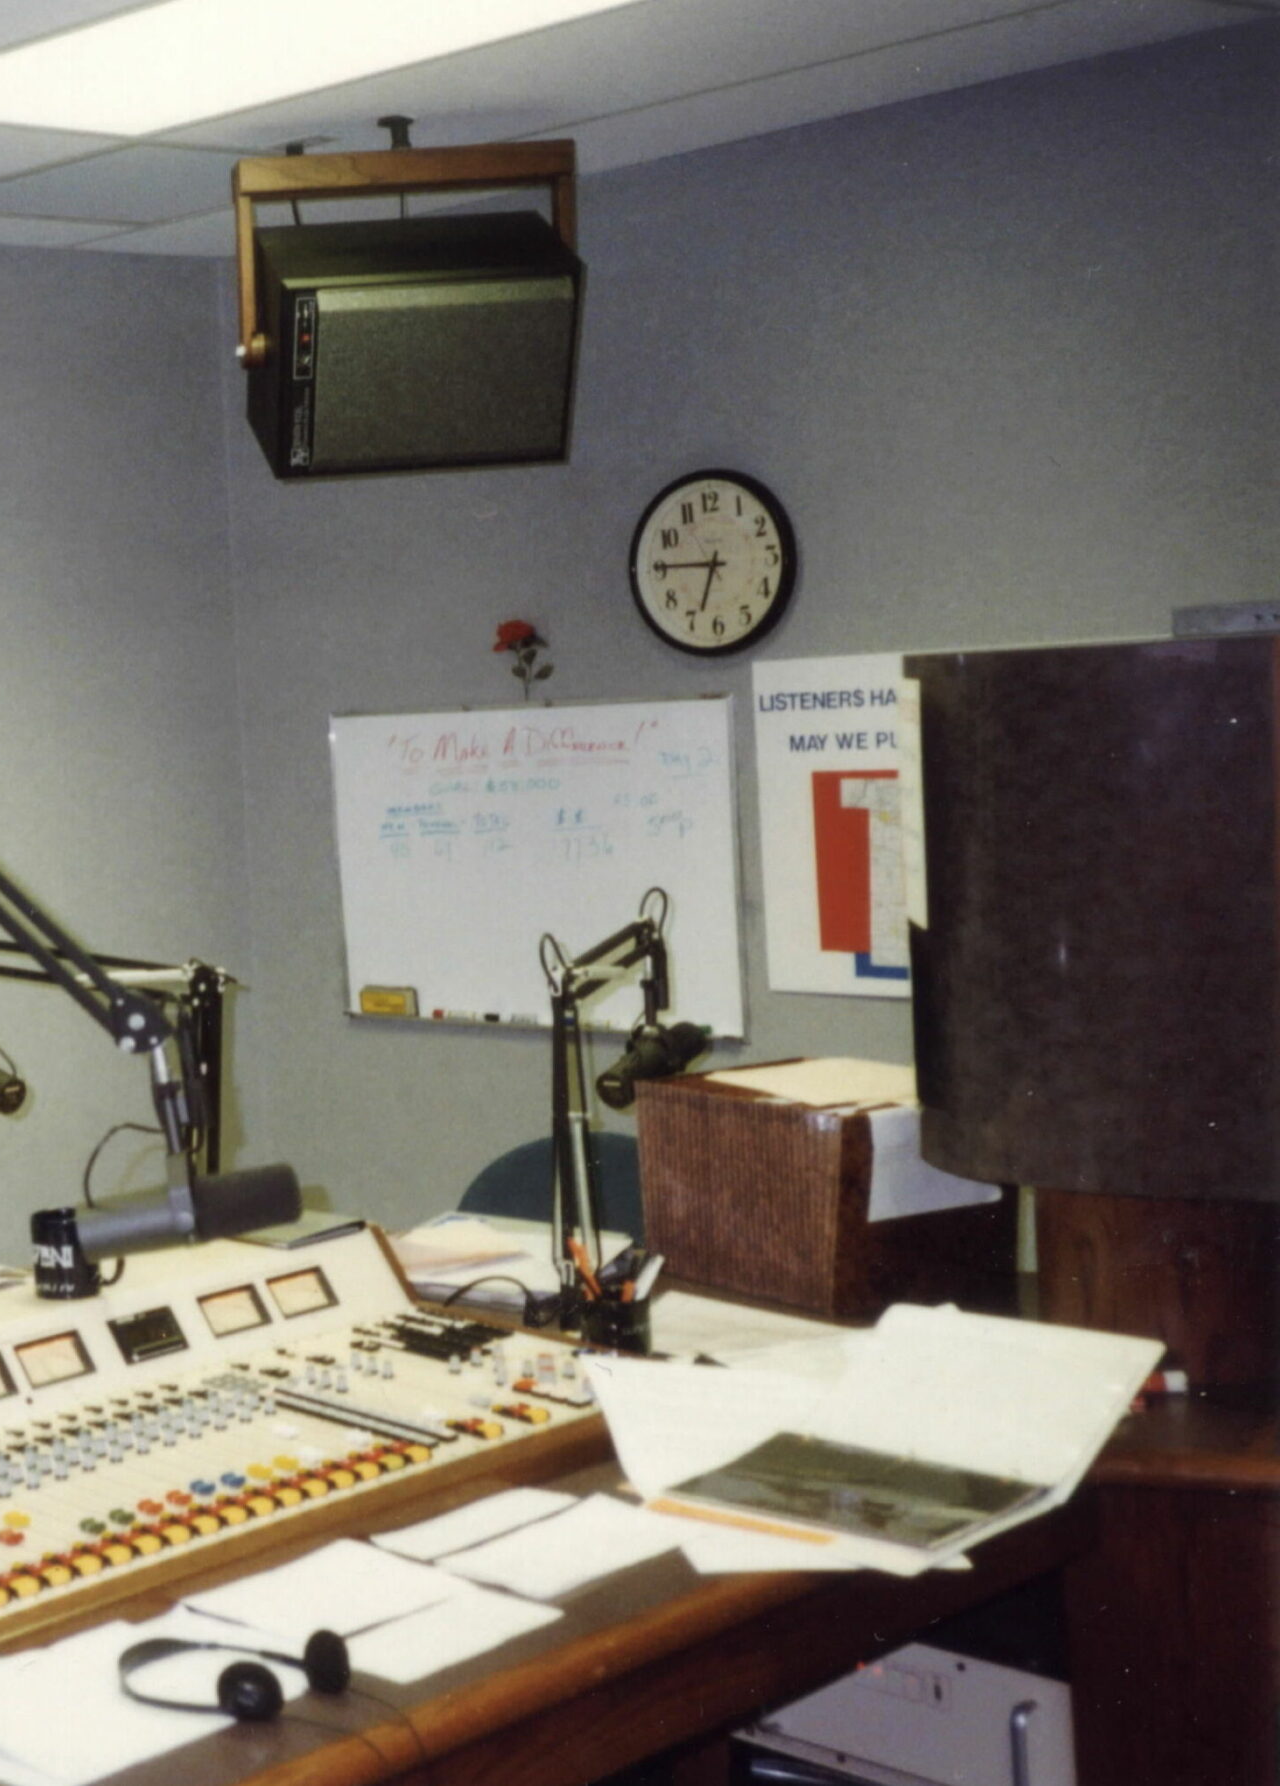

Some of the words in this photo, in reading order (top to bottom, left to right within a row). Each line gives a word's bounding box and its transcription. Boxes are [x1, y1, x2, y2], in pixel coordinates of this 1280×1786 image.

[701, 491, 720, 513] 12
[736, 495, 742, 516] 1
[680, 503, 694, 525] 11
[754, 517, 767, 537] 2
[661, 528, 679, 549] 10
[764, 545, 780, 566] 3
[757, 577, 772, 599] 4
[665, 589, 678, 609] 8
[685, 611, 698, 632] 7
[712, 615, 726, 636] 6
[738, 605, 753, 626] 5
[759, 689, 865, 712] LISTENERS
[789, 733, 828, 752] MAY
[835, 731, 869, 750] WE
